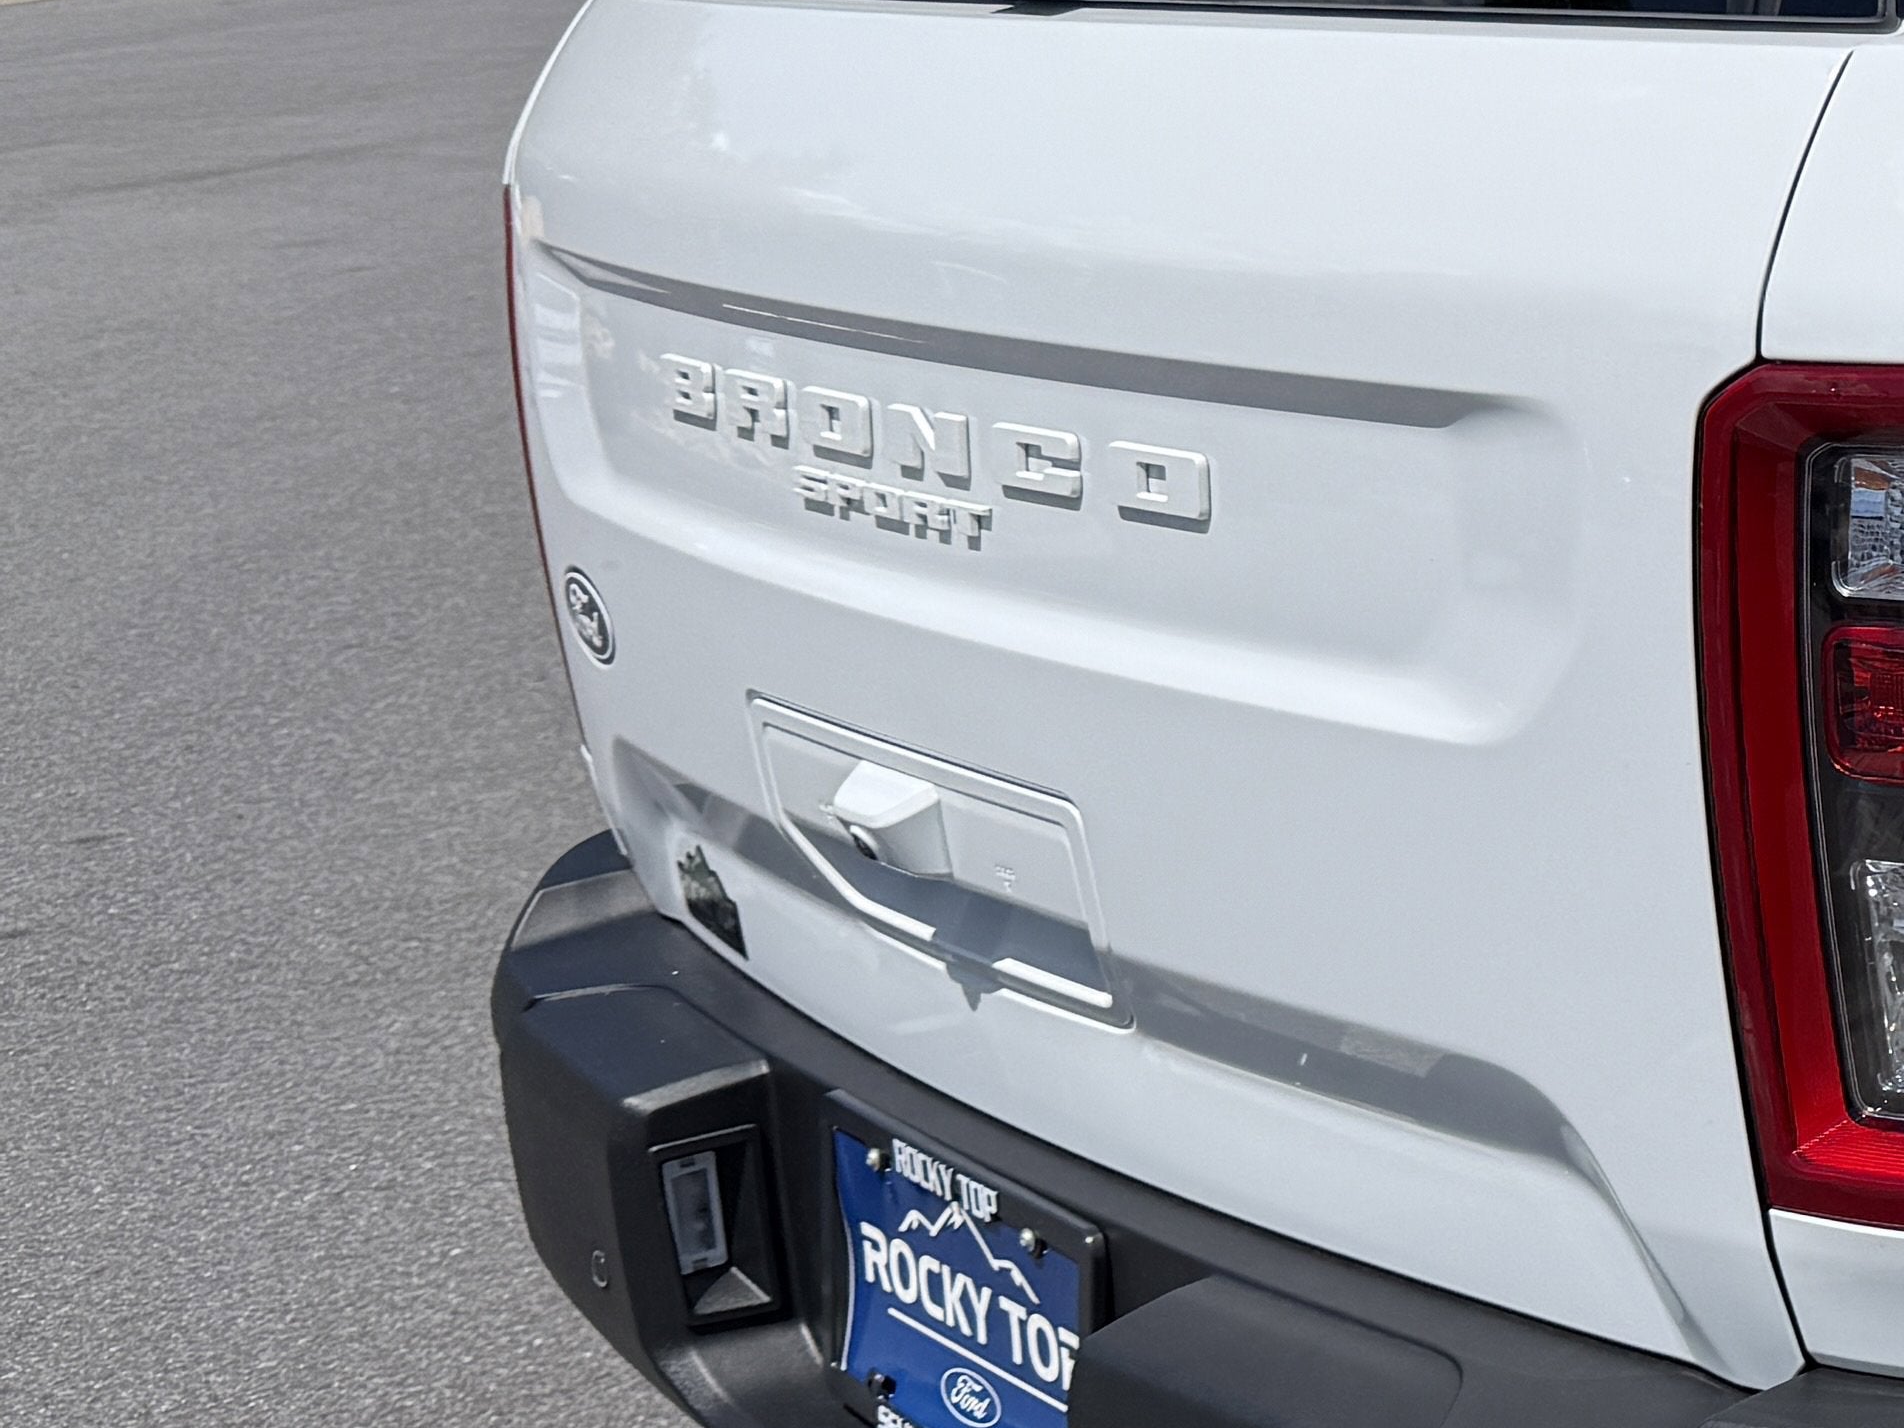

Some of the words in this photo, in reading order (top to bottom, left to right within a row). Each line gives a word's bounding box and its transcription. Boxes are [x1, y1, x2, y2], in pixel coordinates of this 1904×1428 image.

[660, 353, 1212, 530] BRONCO
[793, 464, 993, 542] SPORT
[892, 1138, 955, 1202] ROCKY
[956, 1173, 999, 1223] TOP
[860, 1221, 992, 1346] ROCKY
[950, 1374, 992, 1421] Ford
